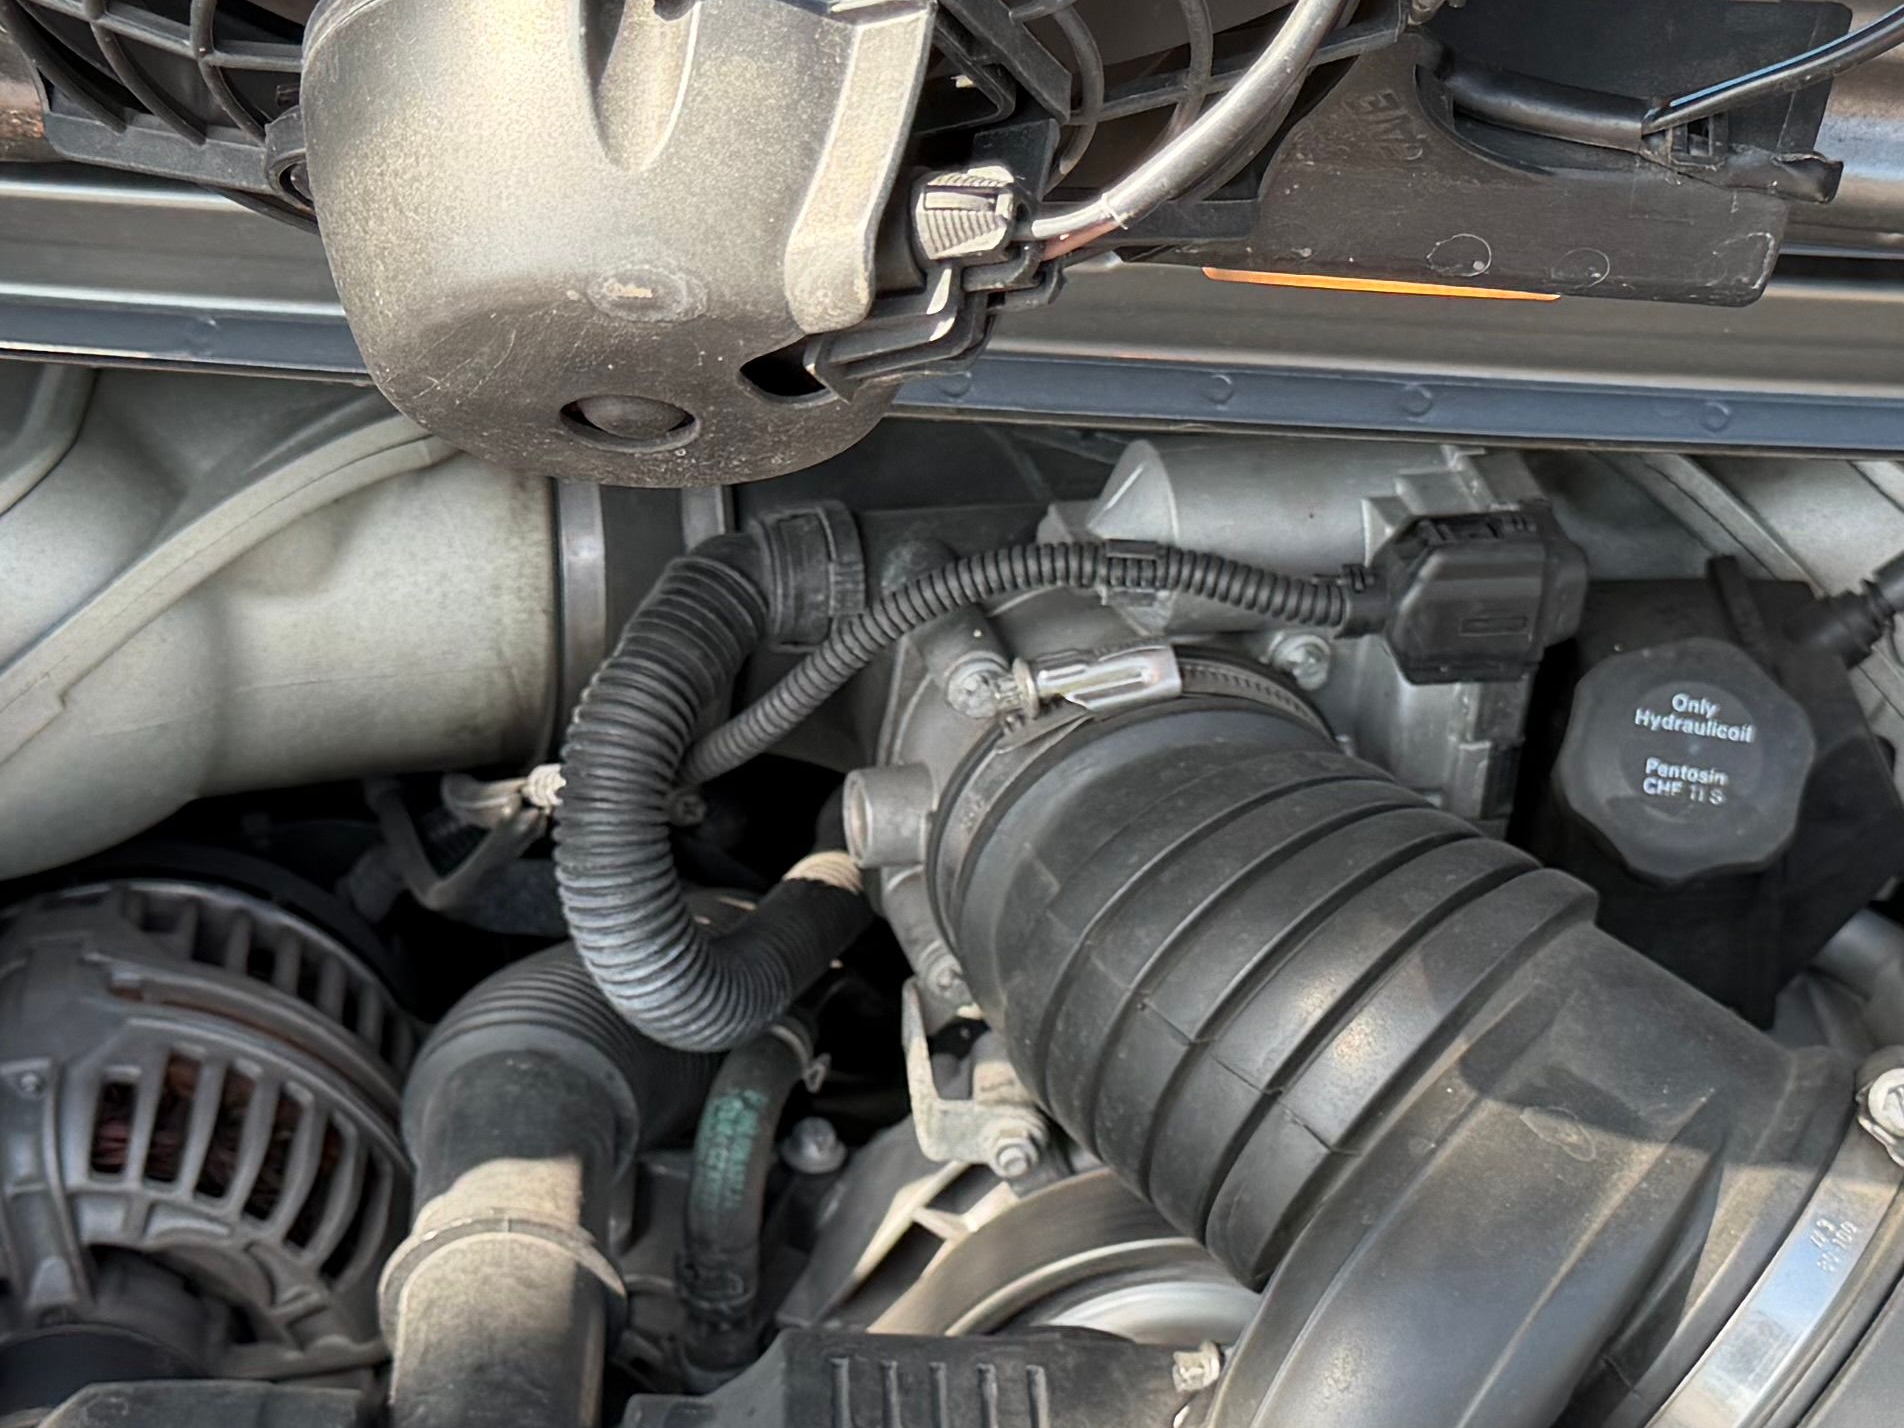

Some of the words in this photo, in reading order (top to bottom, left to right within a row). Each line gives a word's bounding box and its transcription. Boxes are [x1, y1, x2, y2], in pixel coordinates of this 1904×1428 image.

[1671, 693, 1720, 719] Only
[1634, 708, 1755, 743] Hydraulicoil
[1642, 776, 1683, 797] CHF
